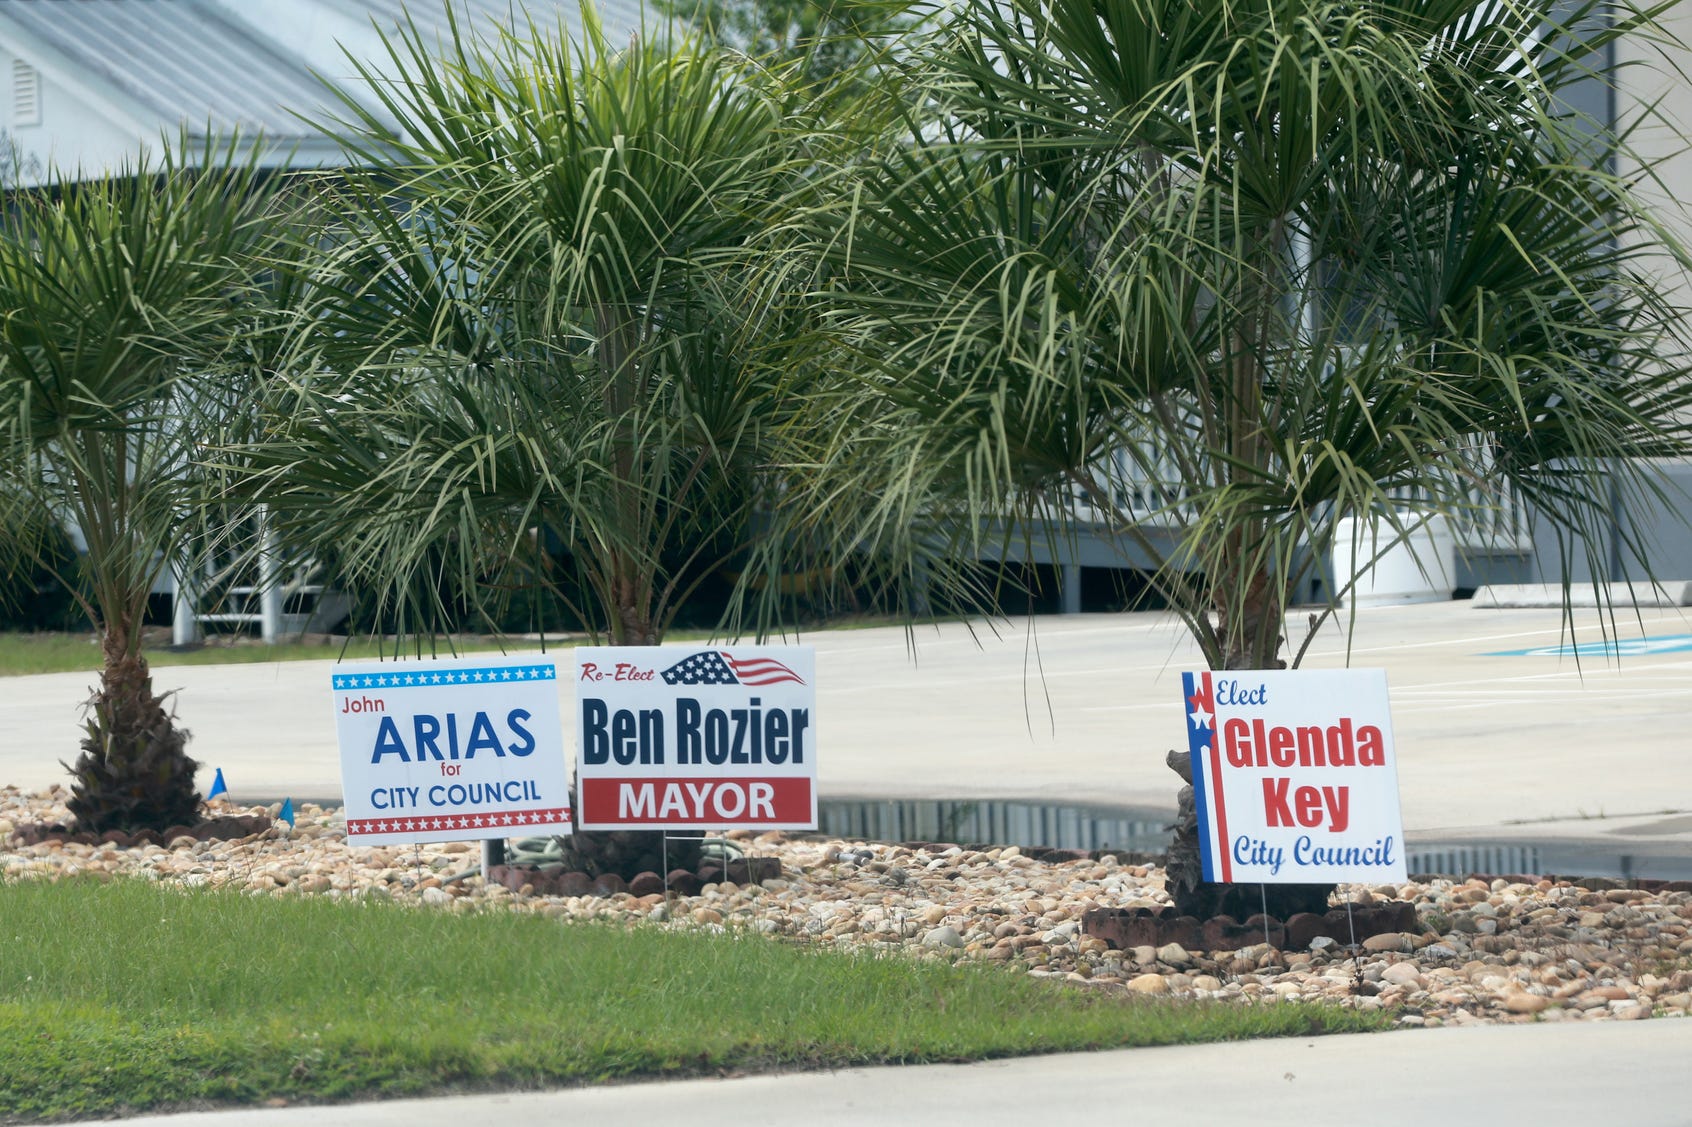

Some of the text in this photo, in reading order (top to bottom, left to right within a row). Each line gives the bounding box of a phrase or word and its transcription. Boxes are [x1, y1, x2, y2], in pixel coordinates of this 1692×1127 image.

[580, 662, 655, 682] Re-Elect
[342, 696, 385, 714] John
[1216, 679, 1268, 706] Elect
[370, 708, 536, 764] ARIAS
[582, 697, 809, 765] Ben Rozier
[1224, 717, 1386, 768] Glenda
[440, 762, 461, 776] for
[370, 780, 541, 809] CITY COUNCIL
[618, 782, 776, 819] MAYOR
[1262, 777, 1350, 833] Key
[1233, 835, 1396, 876] City Council
